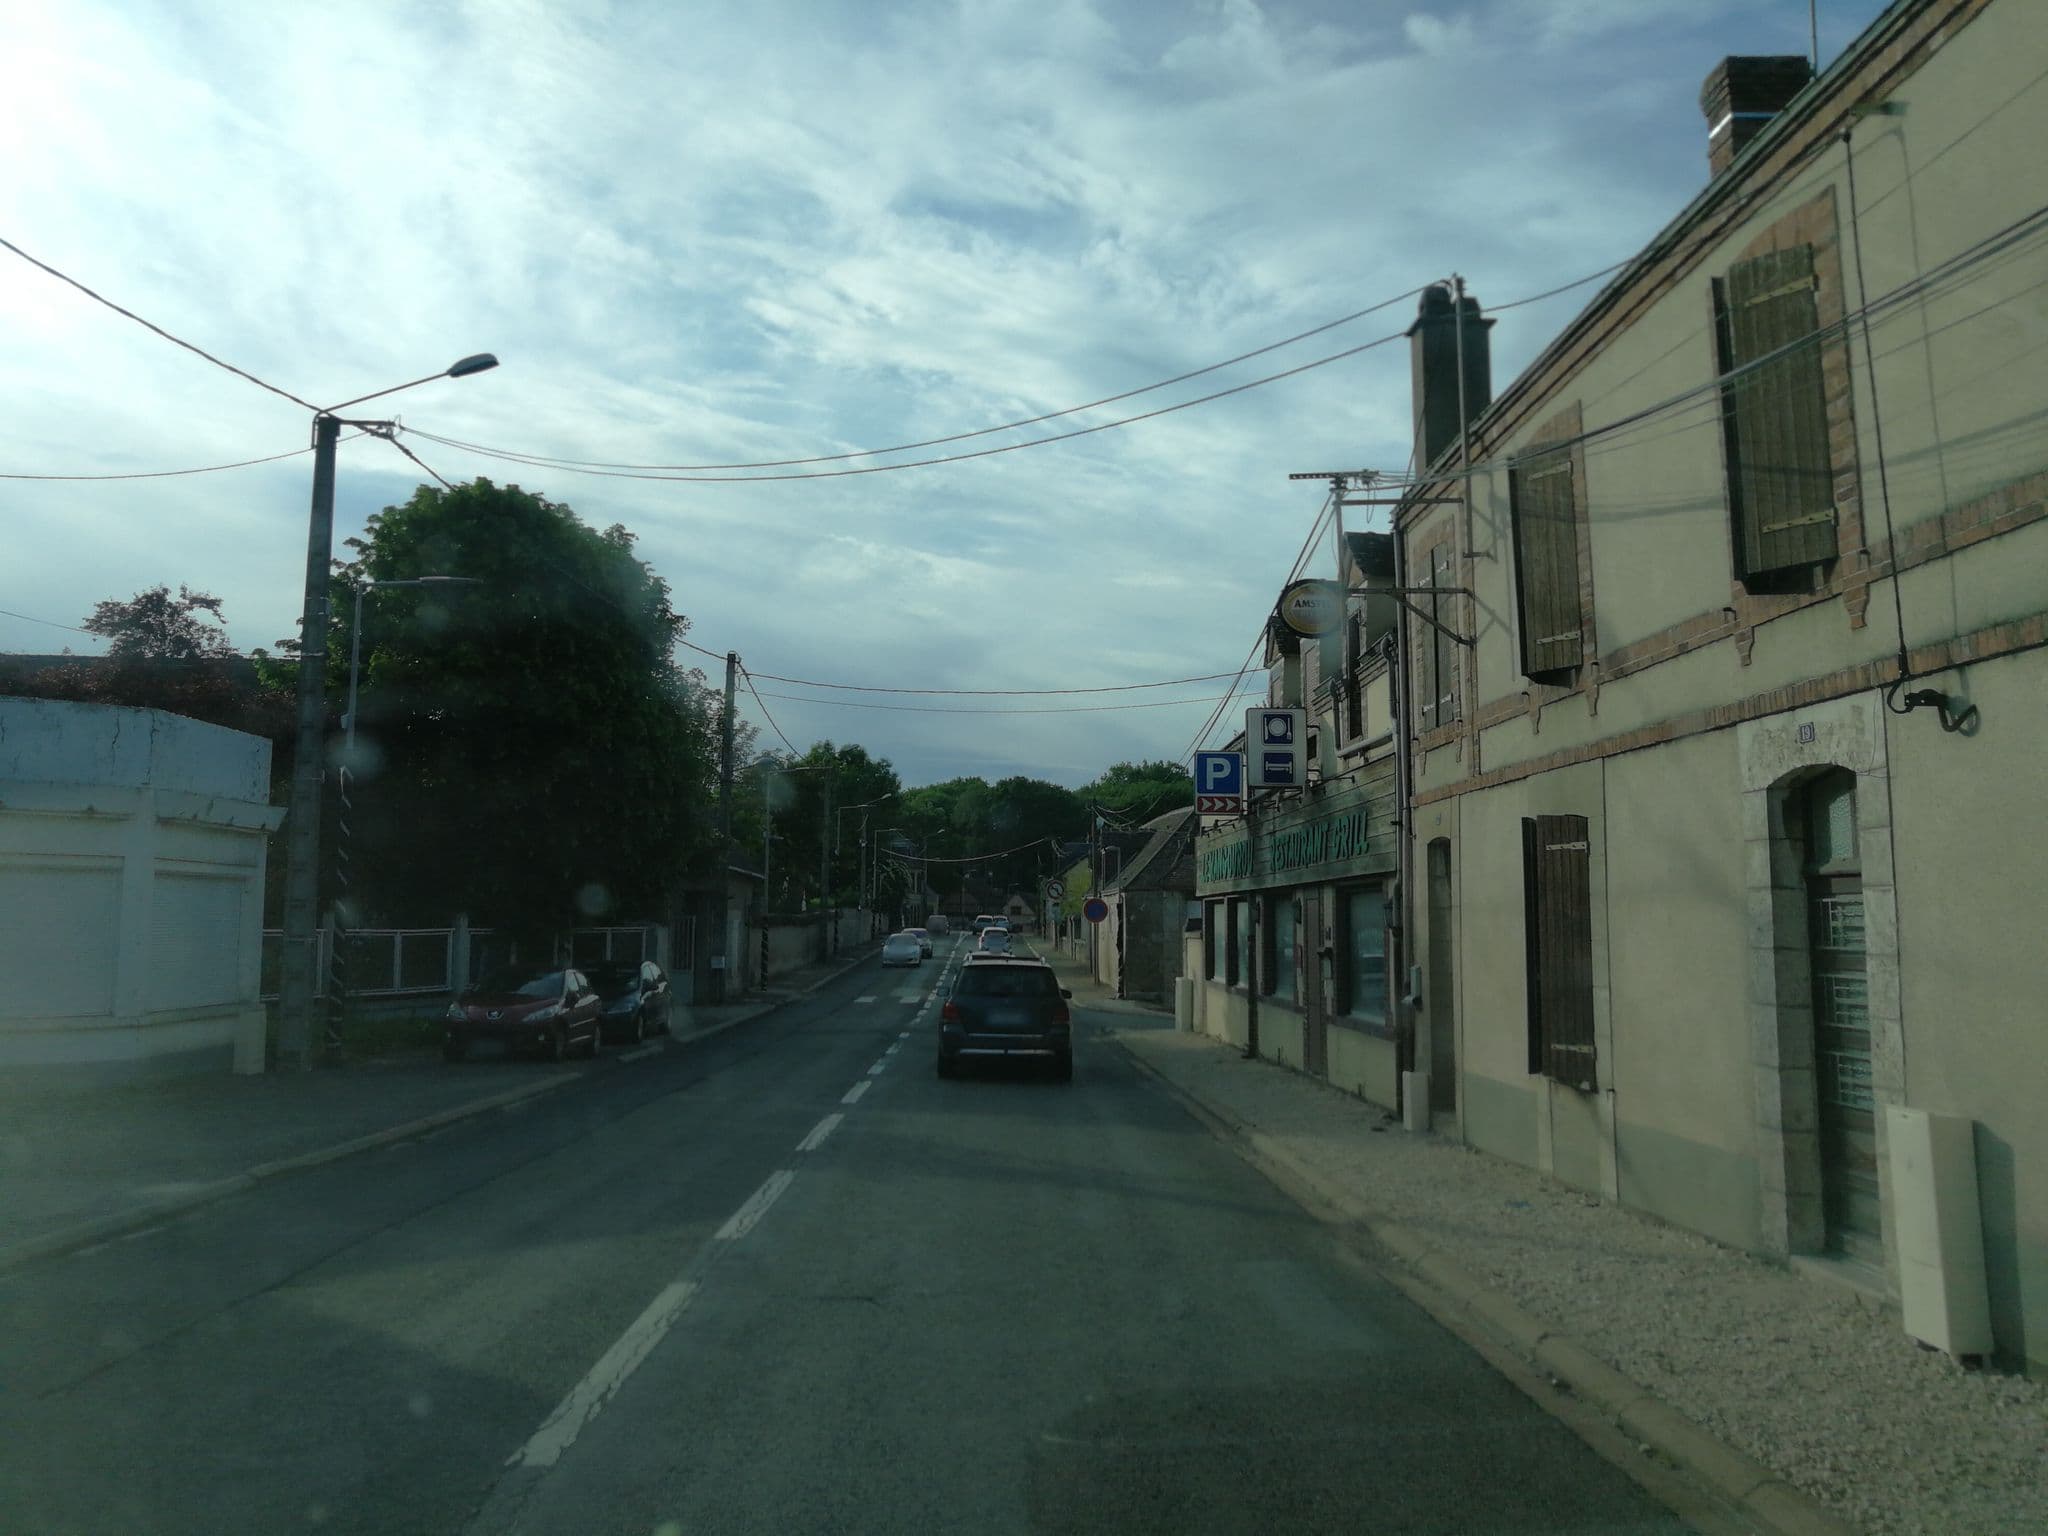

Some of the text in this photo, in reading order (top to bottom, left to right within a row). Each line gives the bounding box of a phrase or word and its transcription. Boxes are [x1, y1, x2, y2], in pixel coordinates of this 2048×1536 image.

[1294, 599, 1330, 608] AMS
[1206, 757, 1232, 790] P
[1271, 812, 1369, 872] RESTAURANT GRILL
